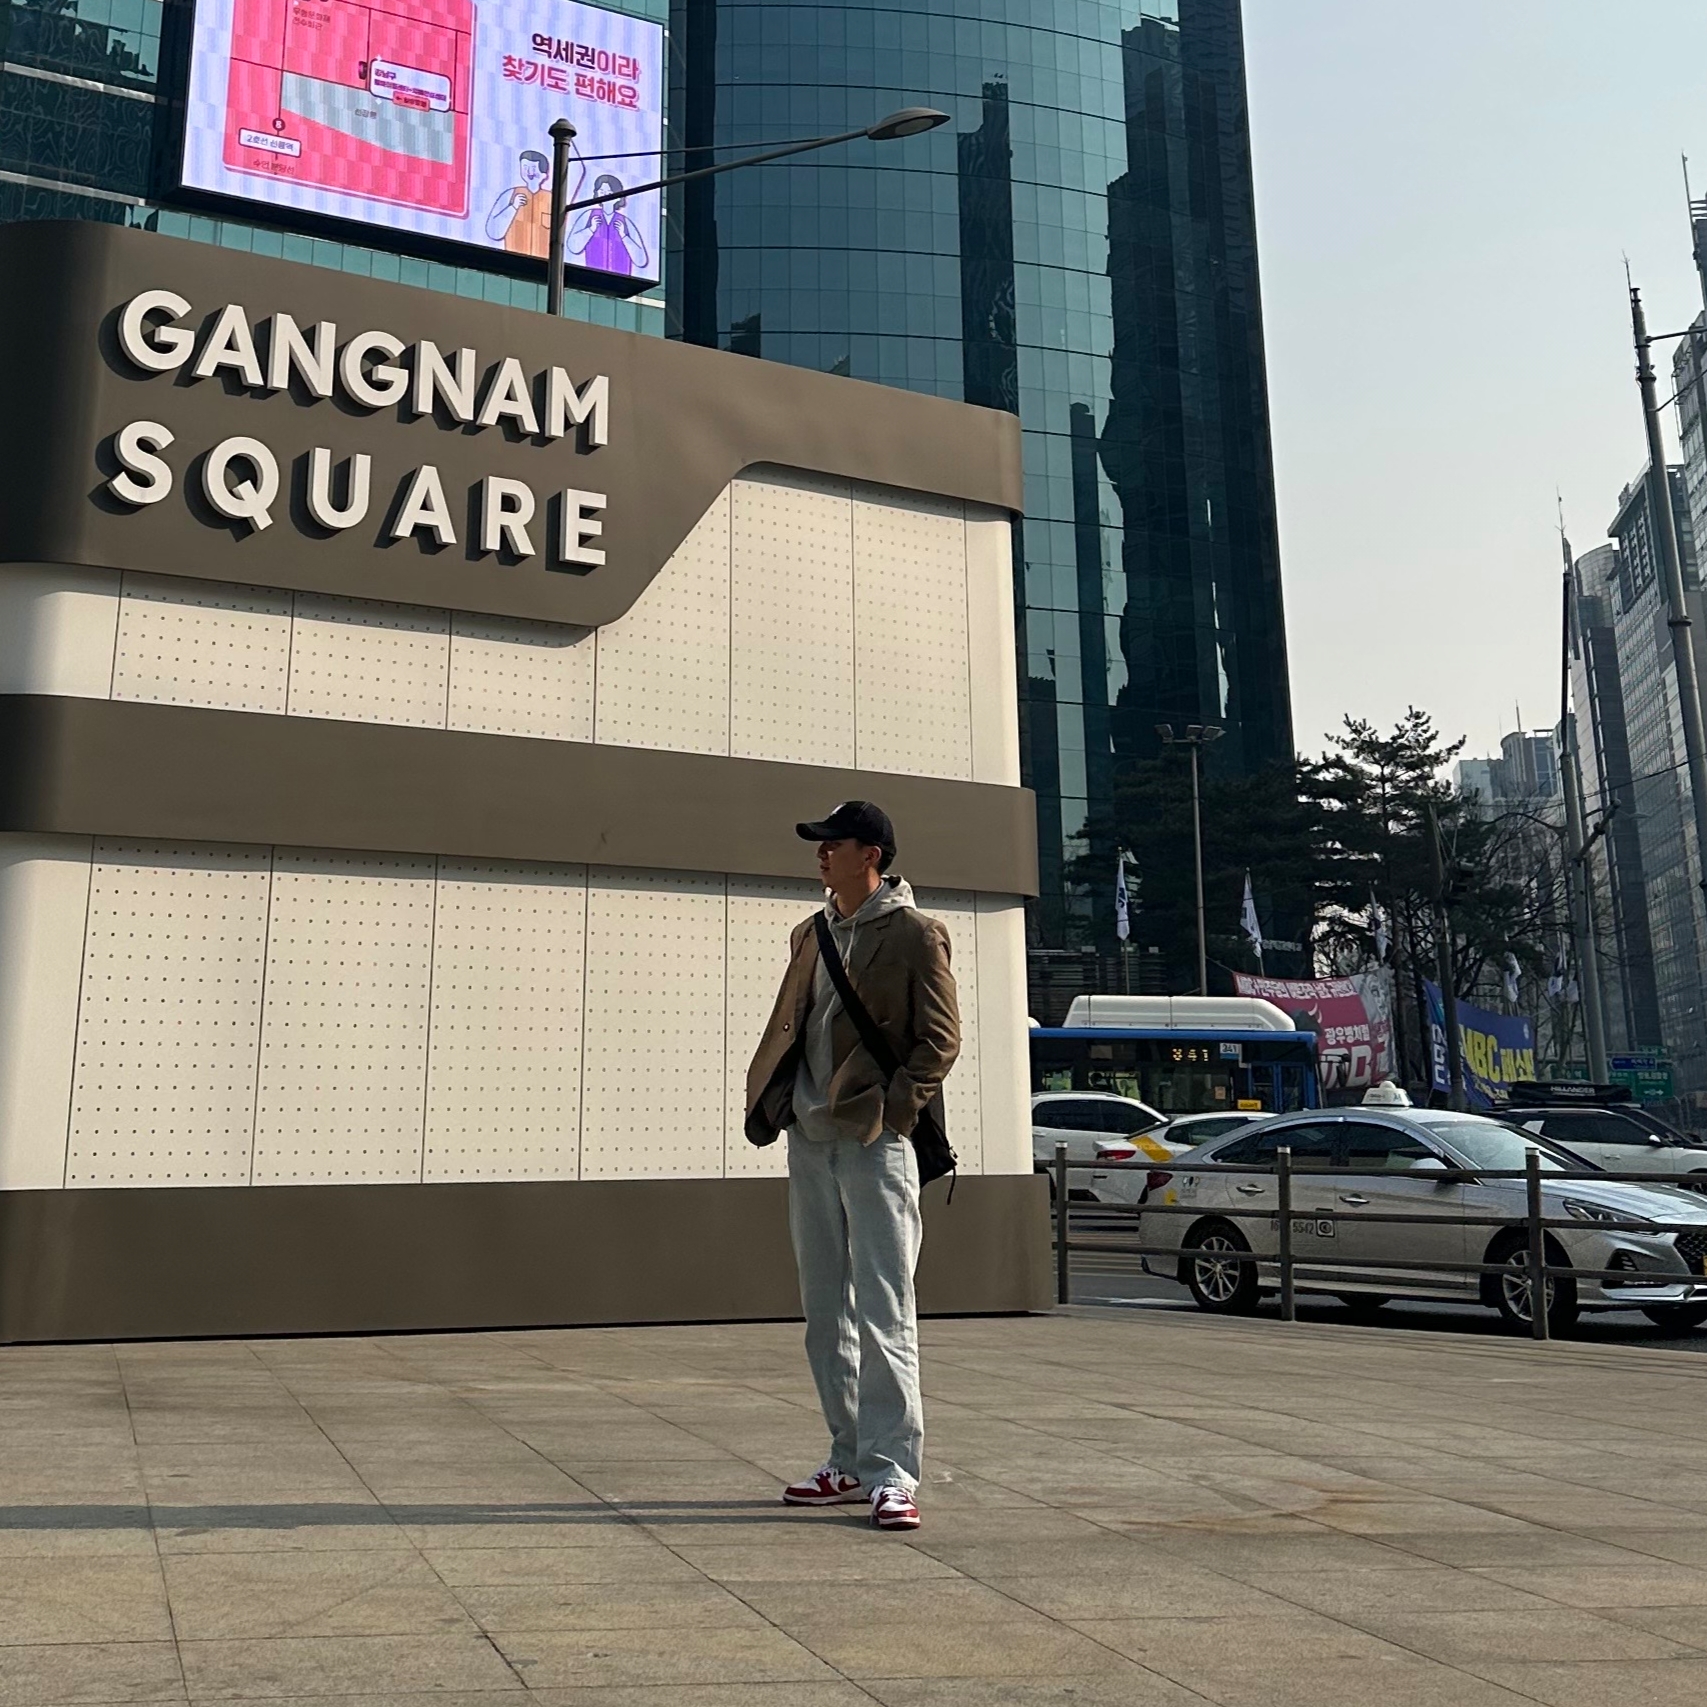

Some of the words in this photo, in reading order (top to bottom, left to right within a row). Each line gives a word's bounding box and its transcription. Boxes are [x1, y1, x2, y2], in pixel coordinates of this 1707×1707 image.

[502, 54, 568, 92] 찾기도
[574, 72, 638, 109] 편해요
[531, 32, 640, 81] 역세권이라
[118, 289, 610, 447] GANGNAM
[107, 420, 608, 567] SQUARE
